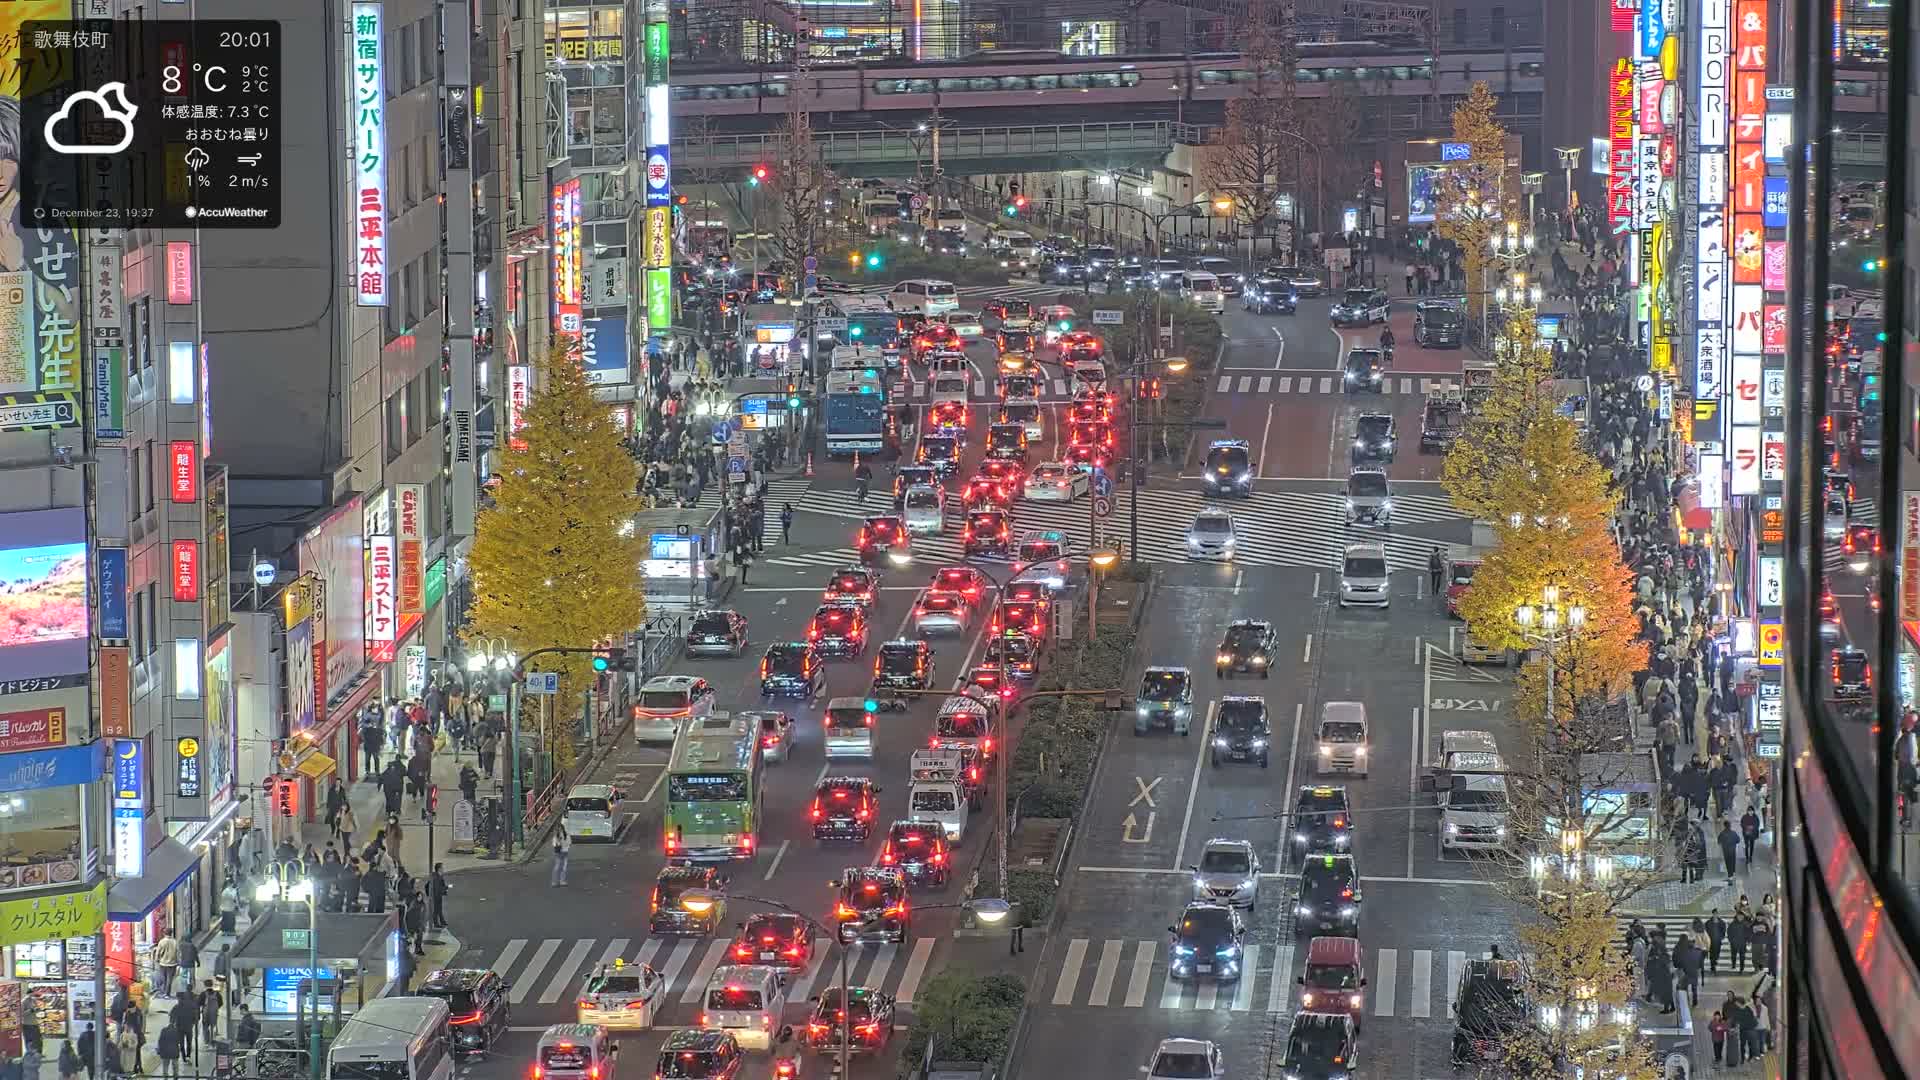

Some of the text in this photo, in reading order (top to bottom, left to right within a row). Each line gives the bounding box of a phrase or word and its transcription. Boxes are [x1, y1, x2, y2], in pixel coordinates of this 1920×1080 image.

[593, 40, 622, 57] 夜間
[357, 15, 380, 173] 新宿サンパーク
[1616, 57, 1633, 138] パチンコ
[1646, 90, 1657, 123] アコム
[1738, 12, 1766, 207] & パーティー
[650, 164, 666, 179] 薬
[1613, 149, 1632, 234] エスパス
[360, 188, 382, 295] 三平本館
[652, 212, 664, 266] 肉汁水餃子
[99, 328, 117, 337] 3F
[1700, 332, 1713, 385] 大衆酒場
[98, 357, 109, 418] FamilyMart
[1735, 311, 1761, 471] パセラ
[1769, 407, 1783, 416] 5F
[456, 411, 470, 463] HOMEGAME
[177, 454, 190, 492] 龍生堂
[402, 490, 413, 535] GAME
[1768, 499, 1780, 508] 3F
[179, 551, 192, 588] 龍生堂
[374, 547, 391, 632] 三平ストア
[315, 584, 324, 624] 389
[51, 716, 60, 739] 5F
[106, 726, 123, 735] B2
[184, 740, 194, 755] 占
[11, 907, 82, 931] クリスタル
